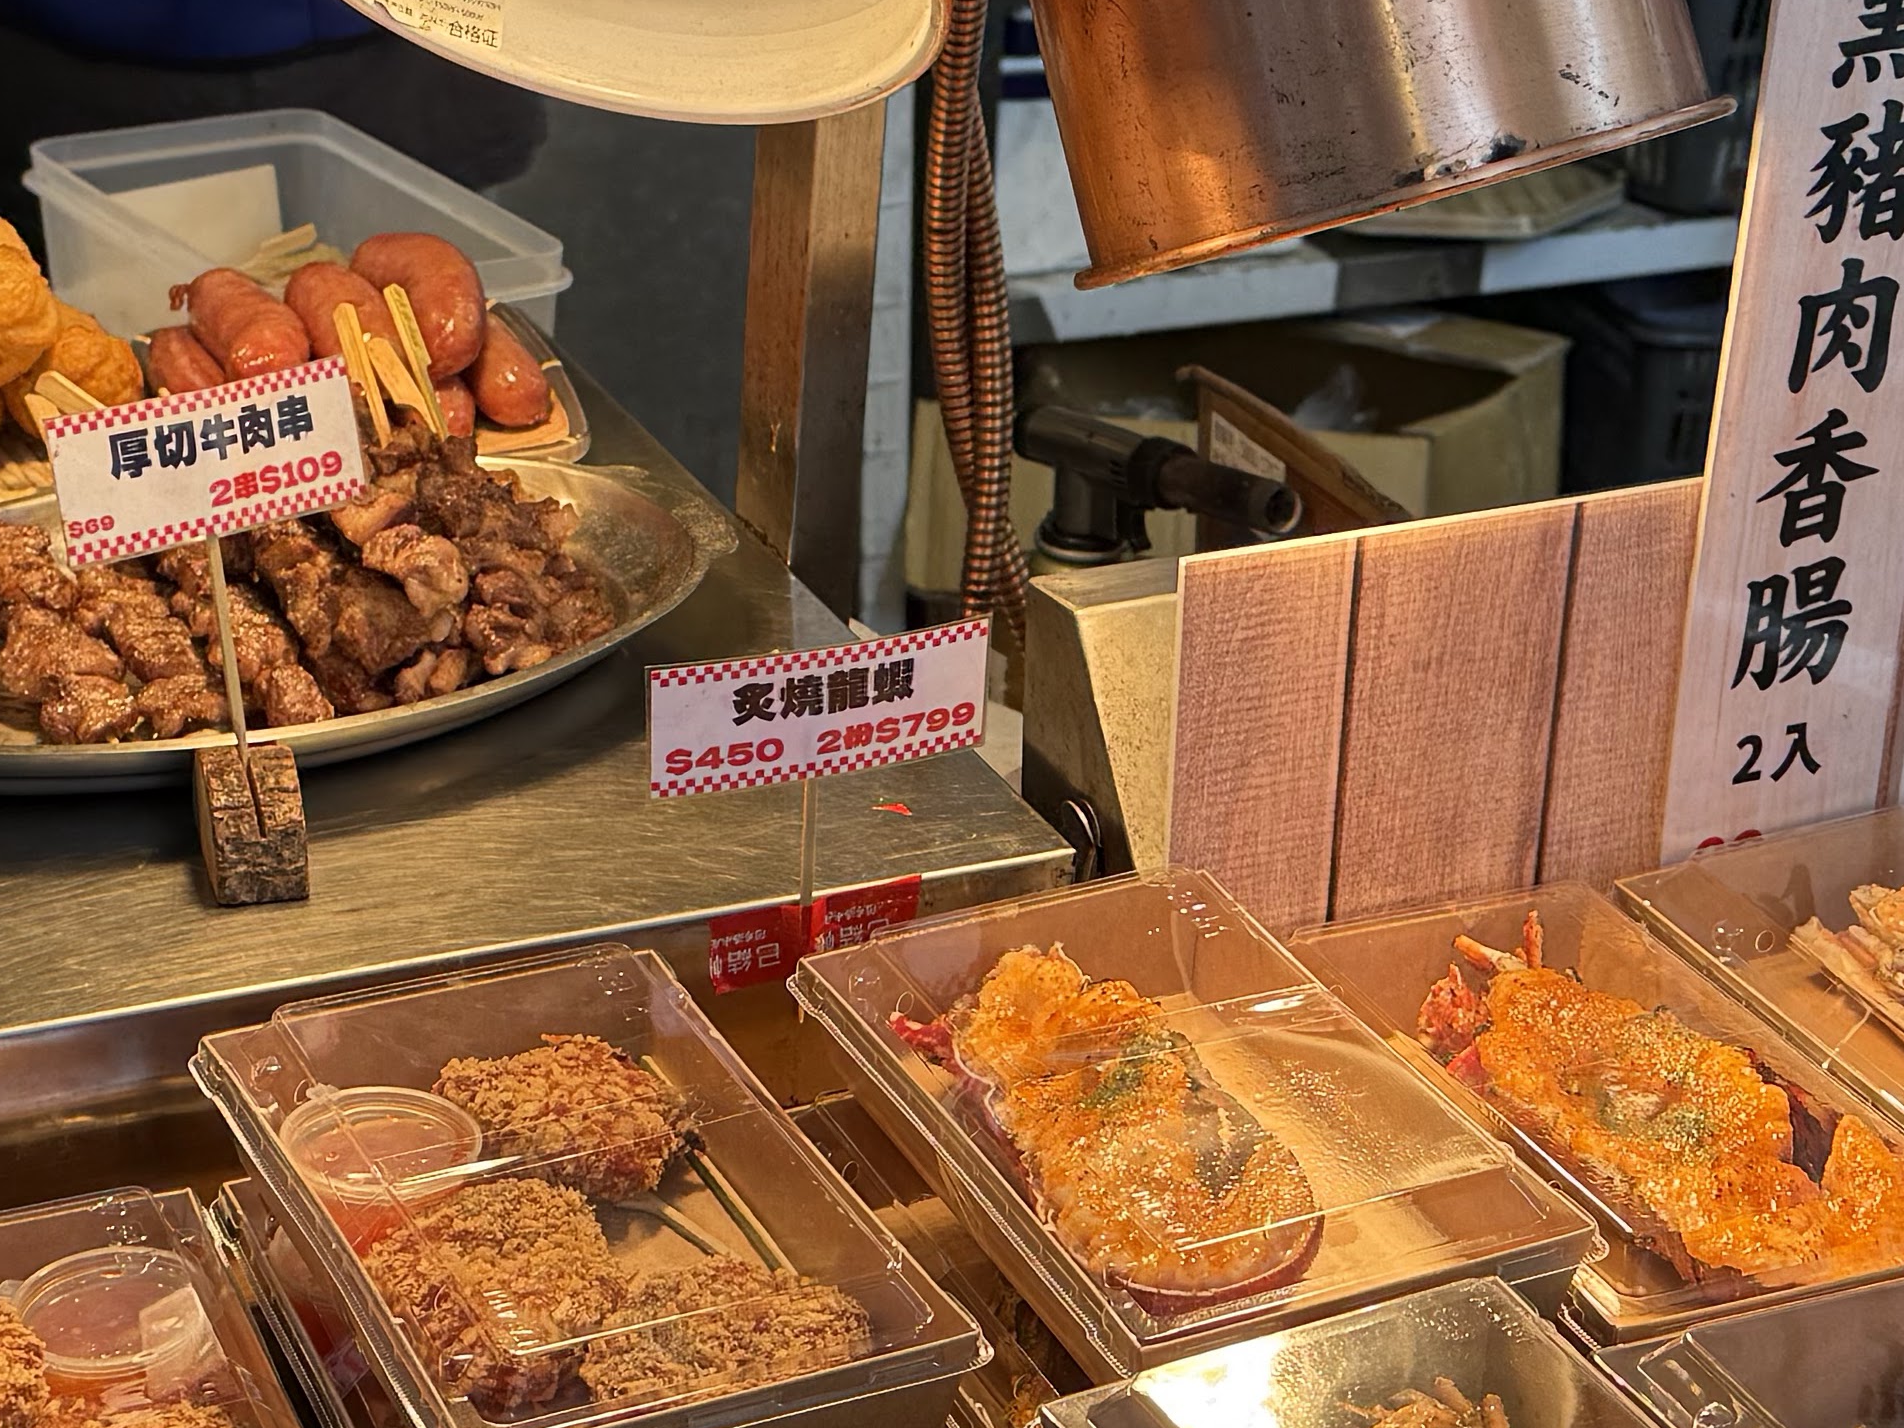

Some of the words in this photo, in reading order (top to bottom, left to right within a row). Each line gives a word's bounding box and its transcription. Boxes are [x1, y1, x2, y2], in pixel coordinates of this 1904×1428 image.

[108, 394, 315, 481] 厚切牛肉串
[209, 450, 344, 508] 2串$109
[67, 514, 115, 540] $69
[731, 657, 915, 727] 炙燒龍蝦
[665, 737, 786, 776] $450
[816, 701, 977, 756] 2份$799
[1731, 722, 1822, 785] 2入
